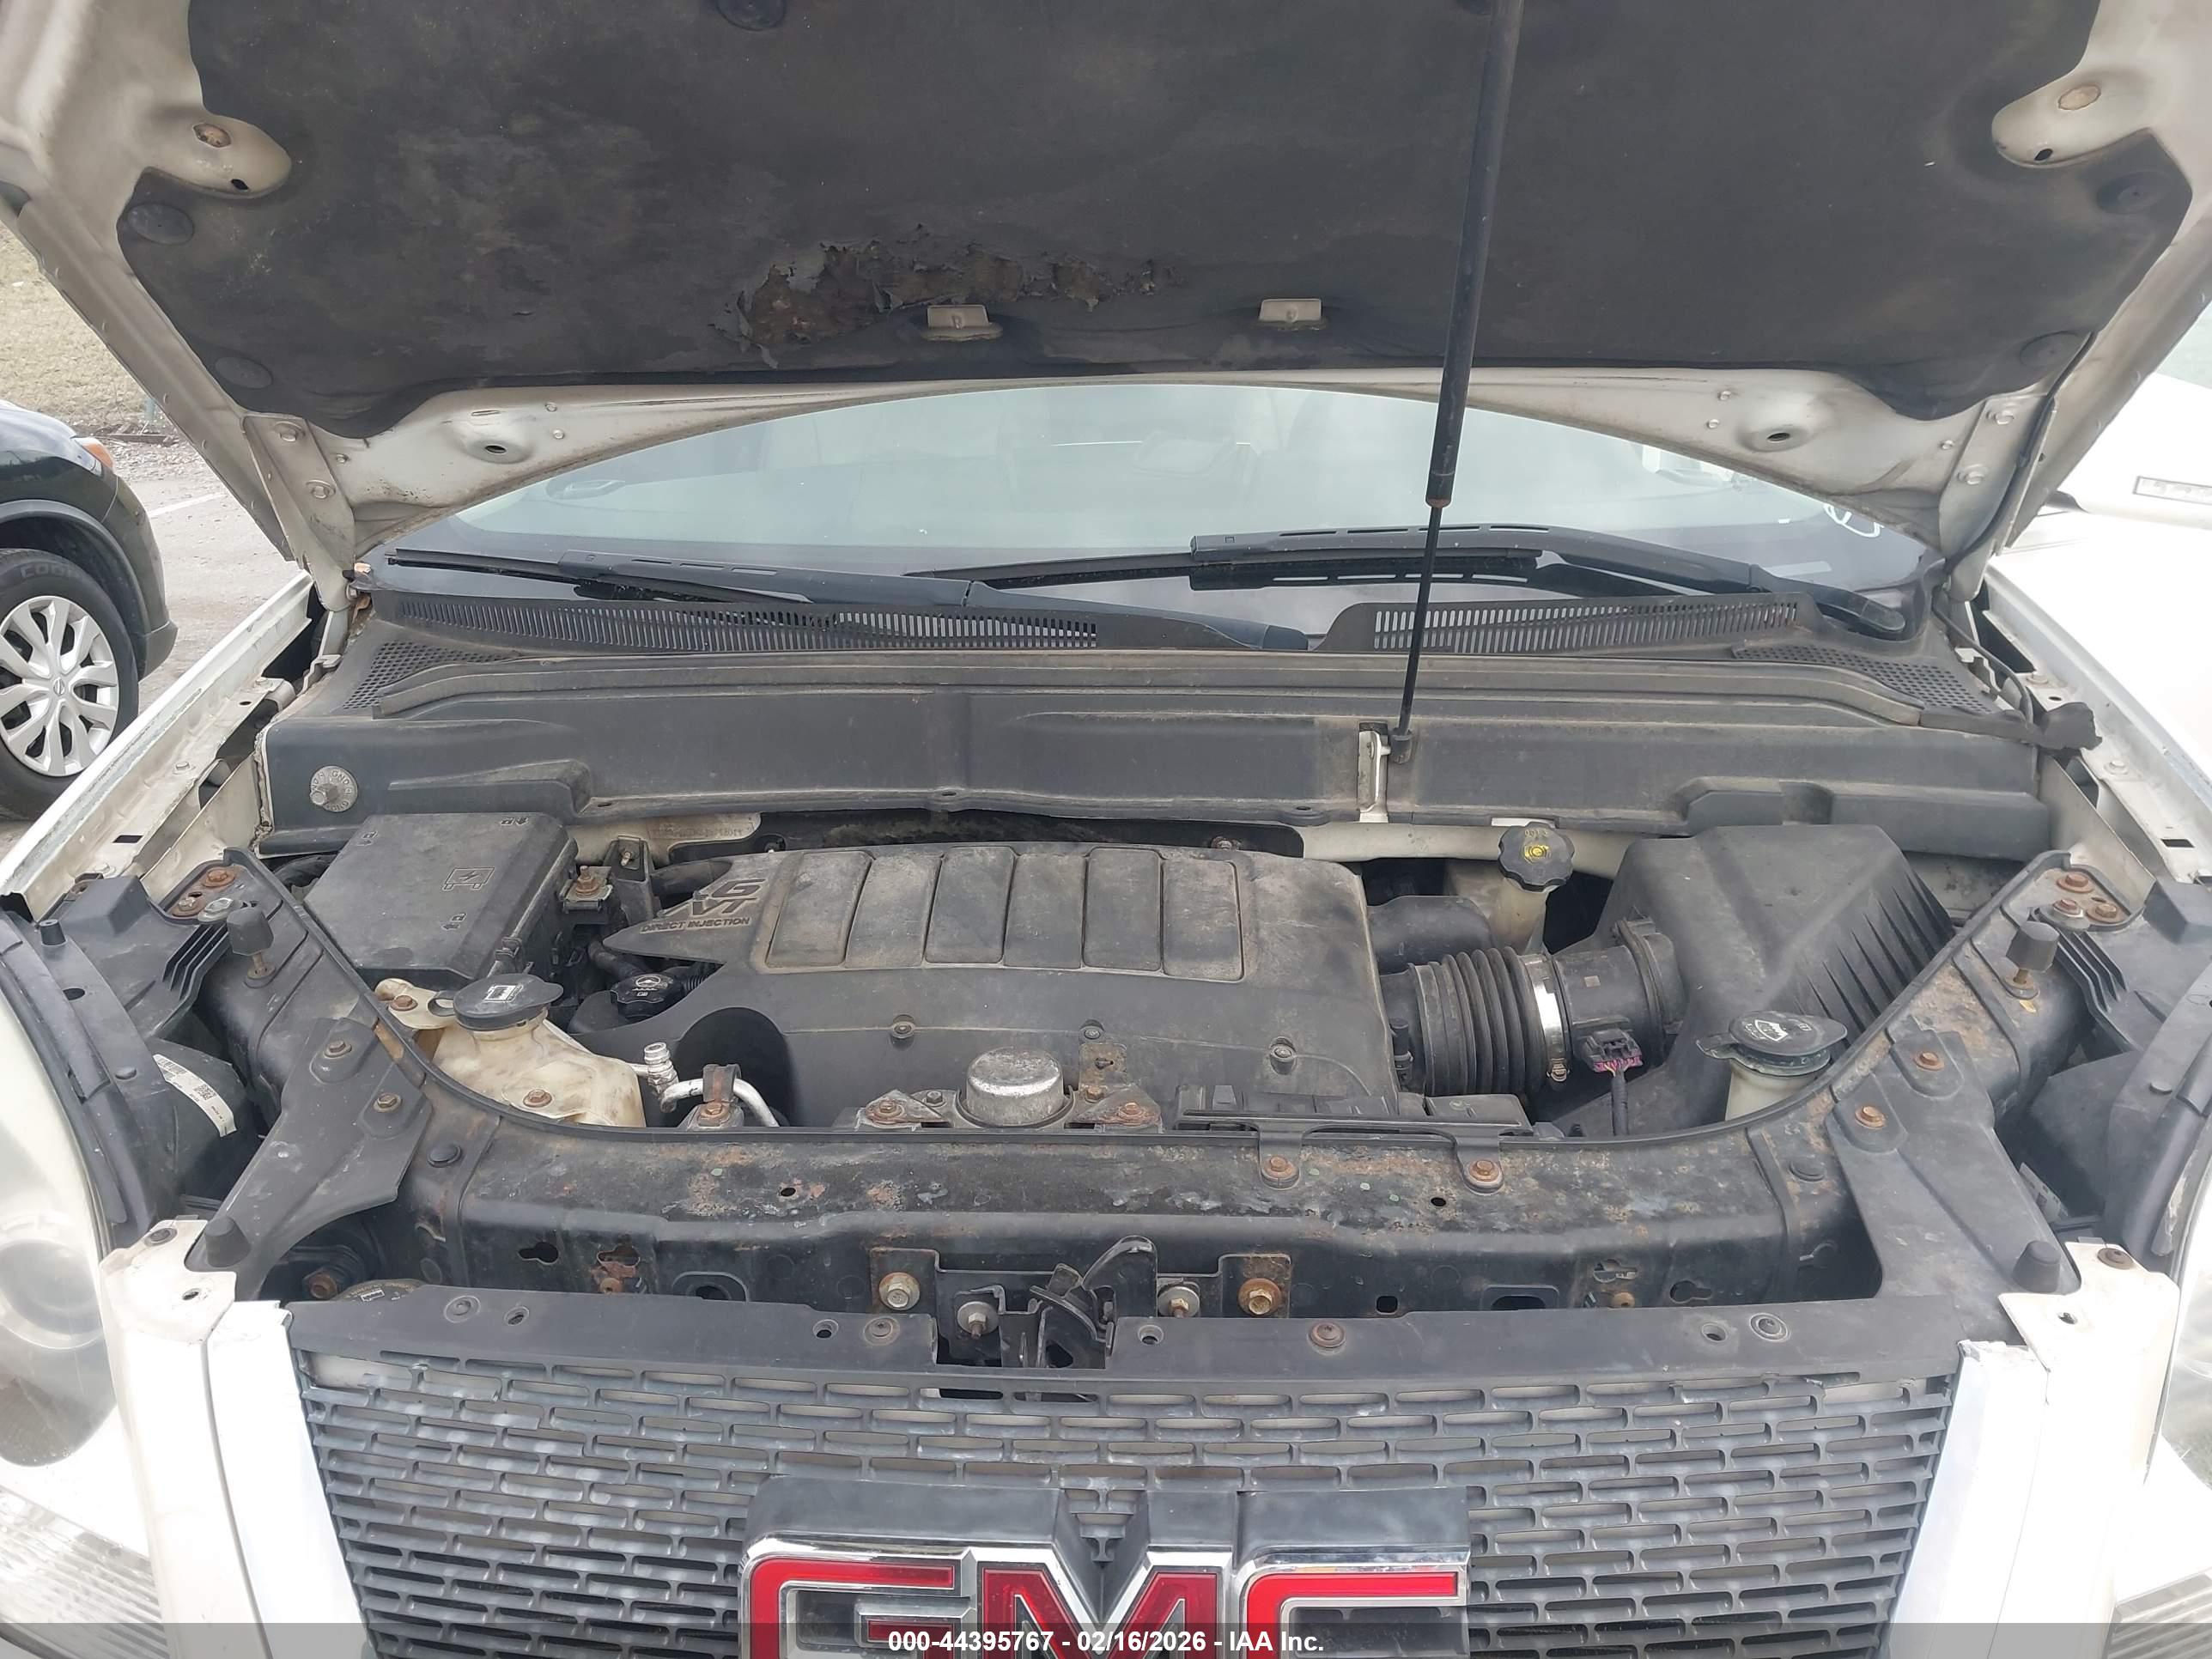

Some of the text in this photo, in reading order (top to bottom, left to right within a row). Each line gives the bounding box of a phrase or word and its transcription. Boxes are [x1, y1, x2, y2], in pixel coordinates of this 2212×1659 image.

[331, 770, 350, 785] GND
[640, 917, 750, 933] DIRECT INJECTION
[738, 1537, 1472, 1659] GMC
